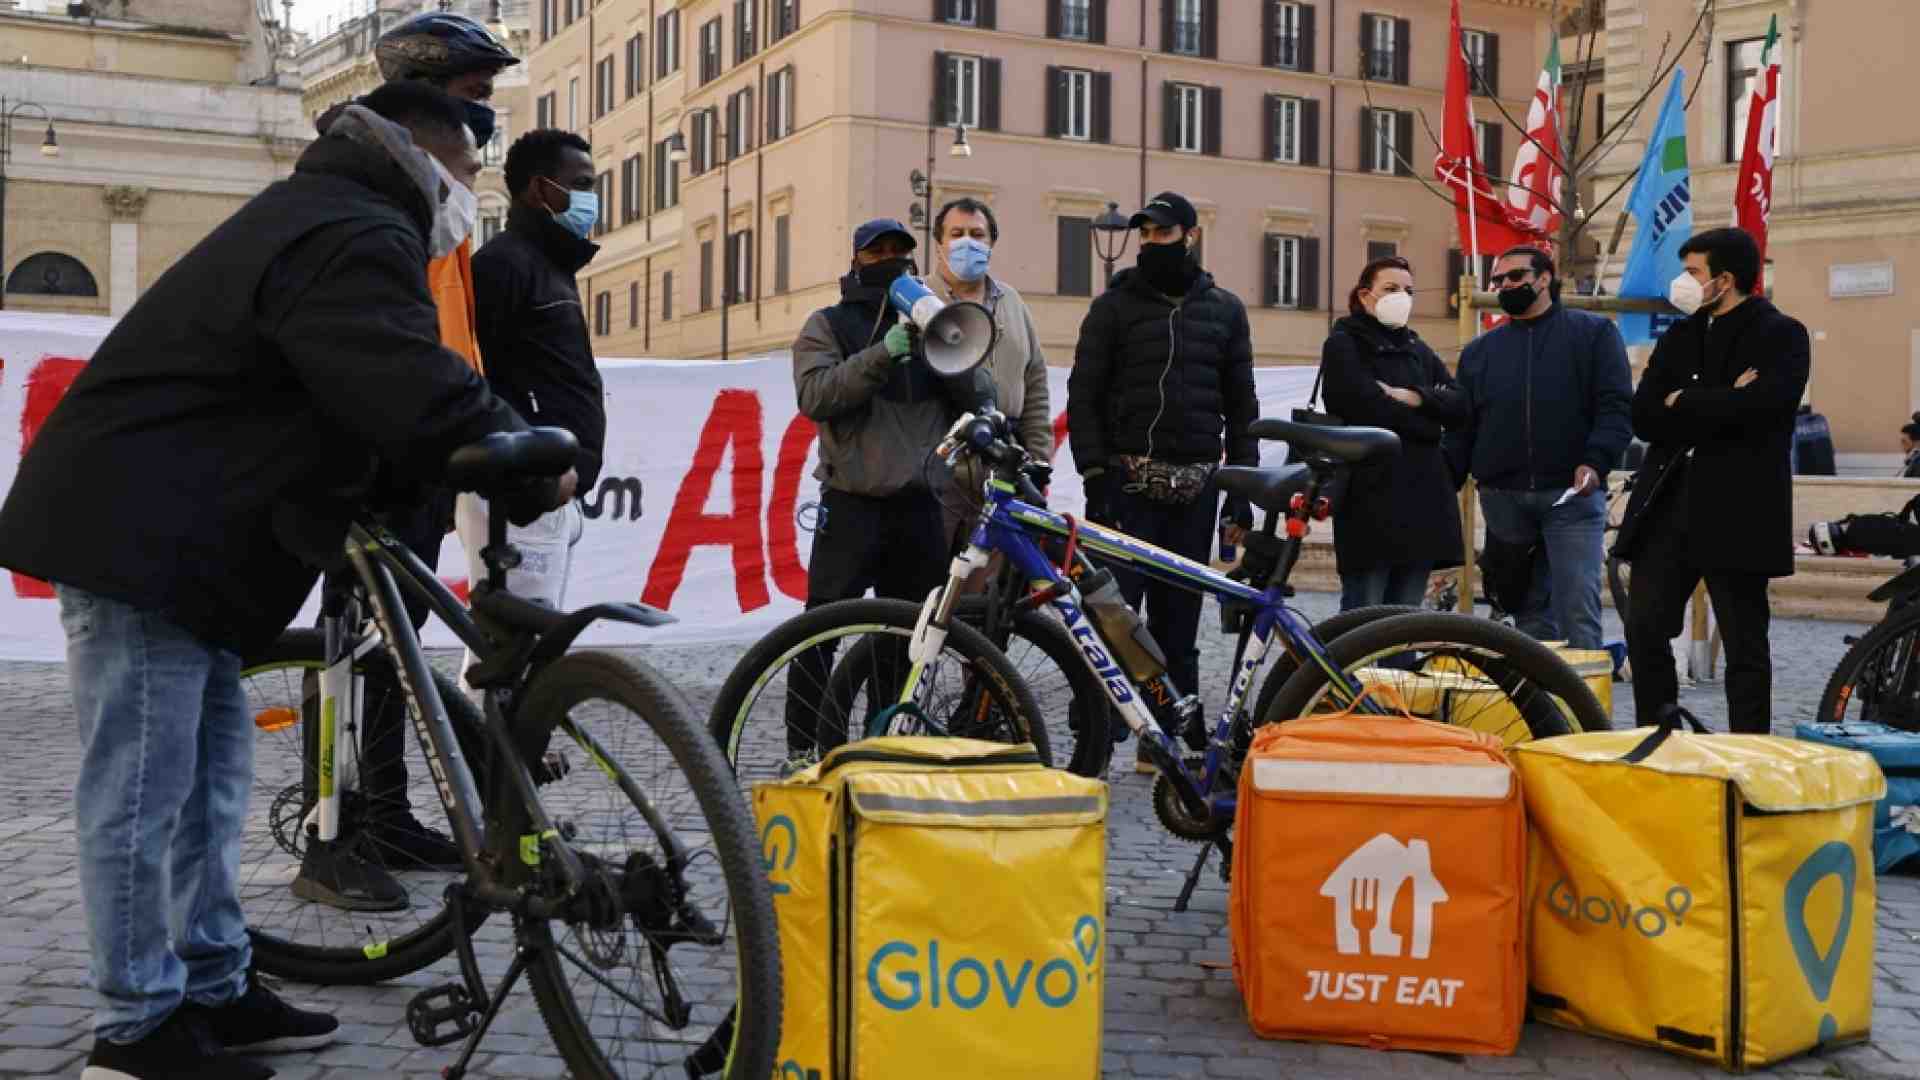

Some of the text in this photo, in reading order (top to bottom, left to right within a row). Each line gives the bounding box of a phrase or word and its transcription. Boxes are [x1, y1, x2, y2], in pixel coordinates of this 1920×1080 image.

[1053, 600, 1134, 704] Atala
[867, 939, 1078, 1011] Glovo
[1303, 970, 1465, 1007] JUST EAT
